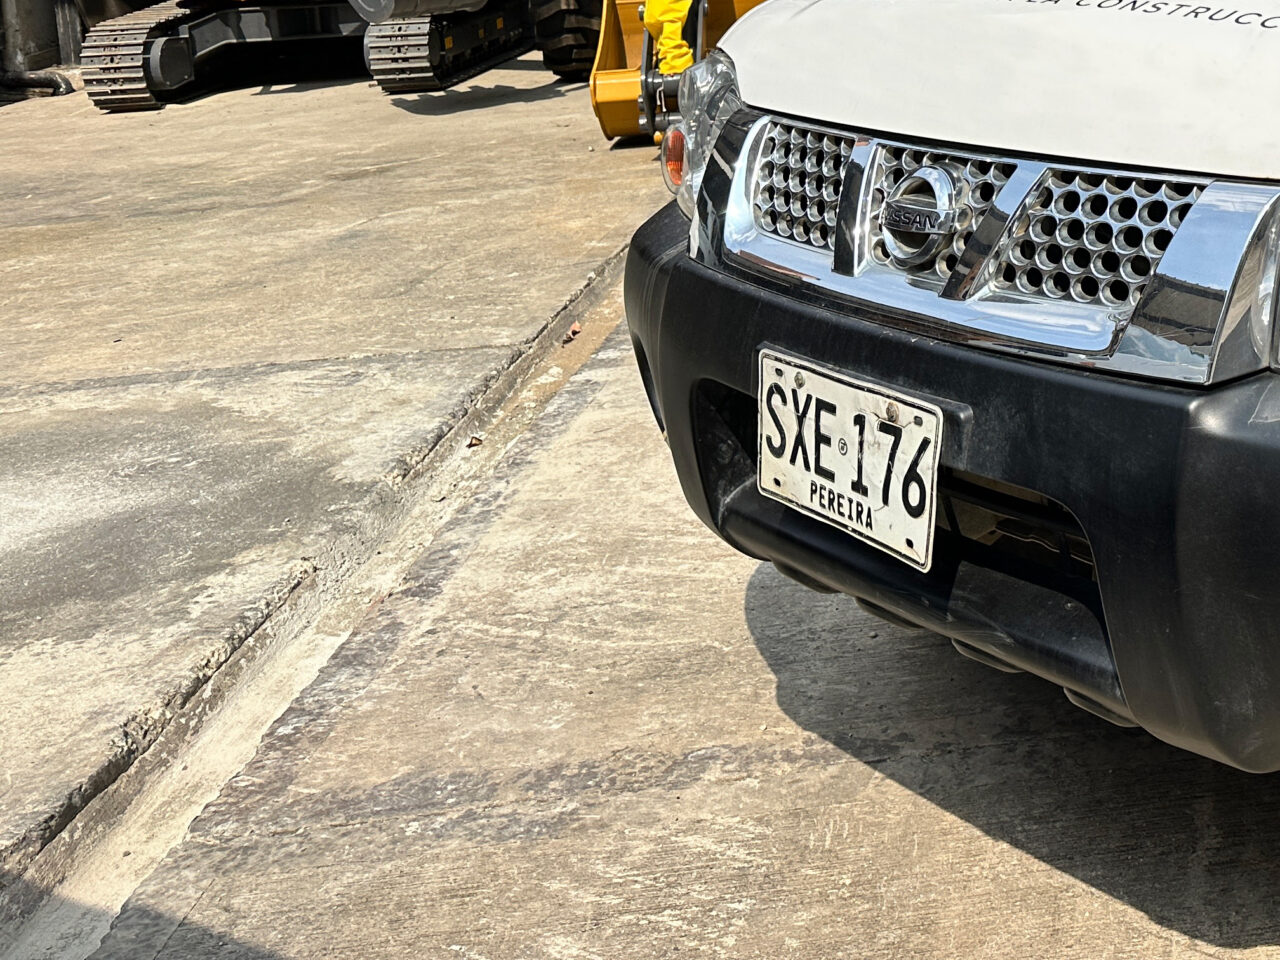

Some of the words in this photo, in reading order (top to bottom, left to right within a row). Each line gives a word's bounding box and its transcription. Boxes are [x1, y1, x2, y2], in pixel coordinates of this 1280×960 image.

[886, 208, 937, 228] SSAN
[765, 382, 837, 483] SXE
[851, 413, 931, 519] 176
[810, 479, 873, 531] PEREIRA
